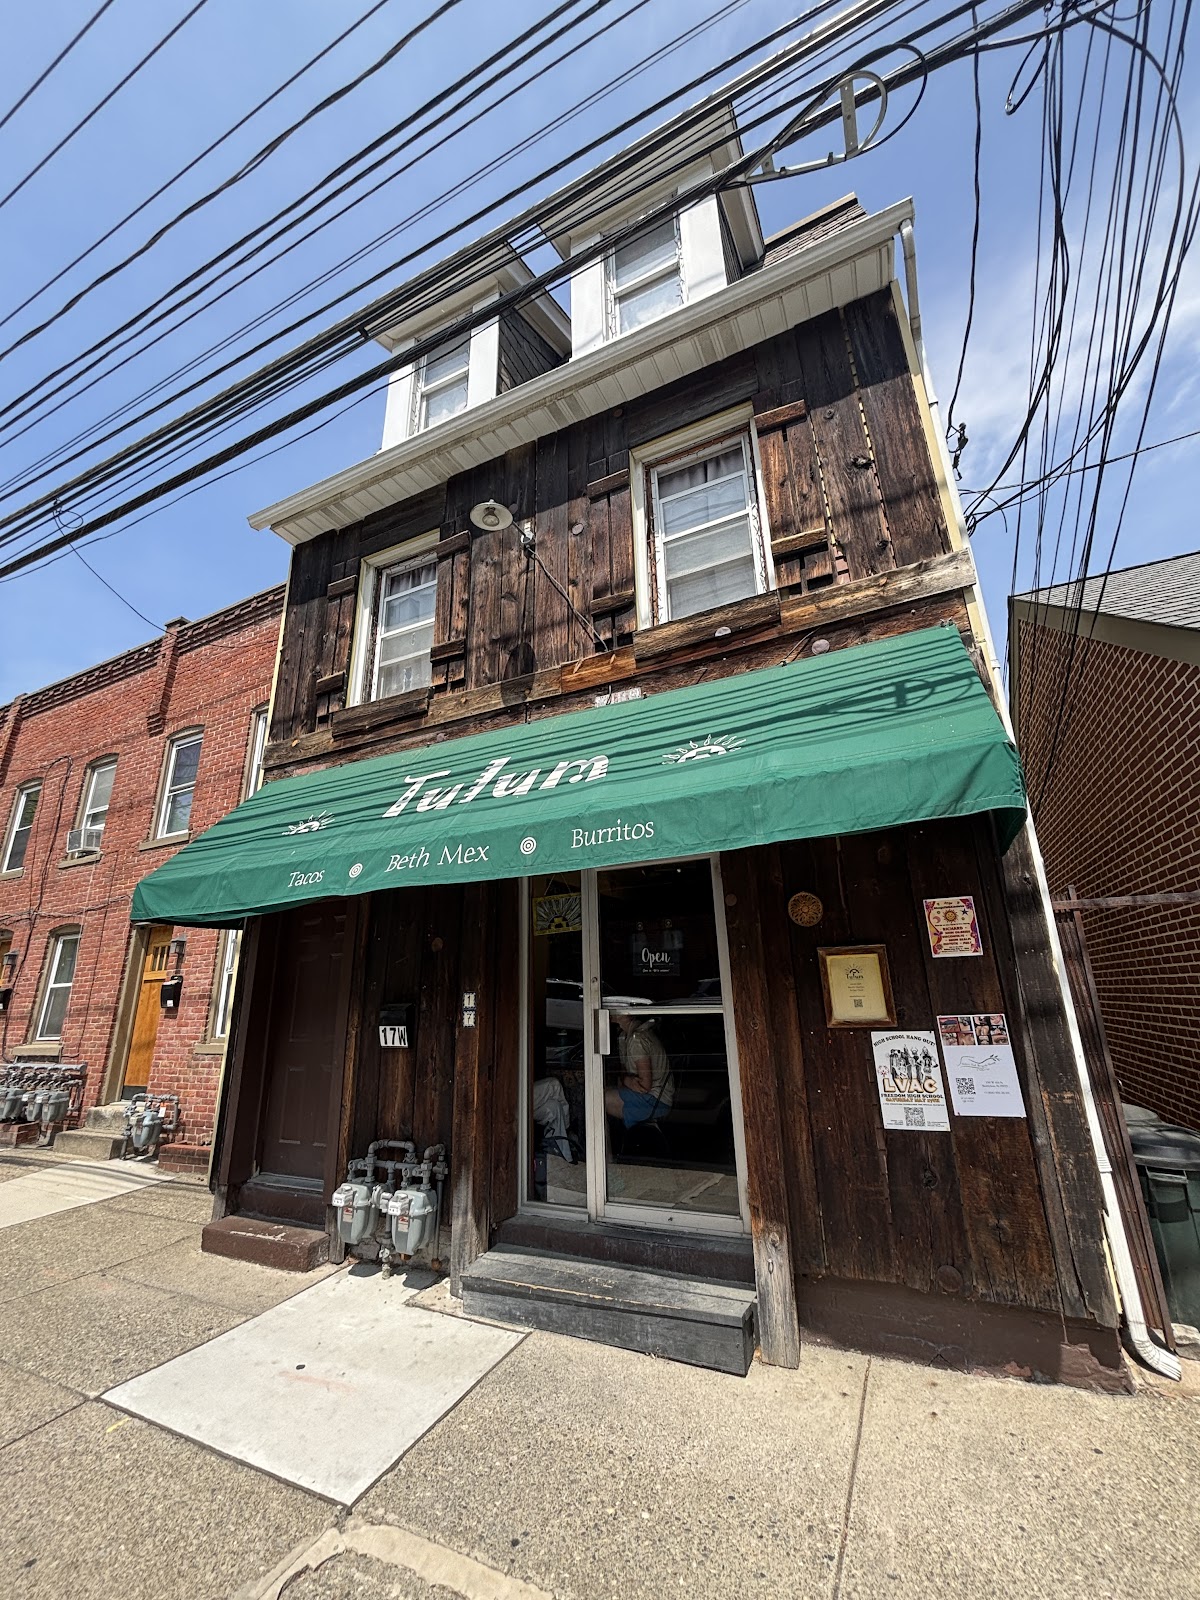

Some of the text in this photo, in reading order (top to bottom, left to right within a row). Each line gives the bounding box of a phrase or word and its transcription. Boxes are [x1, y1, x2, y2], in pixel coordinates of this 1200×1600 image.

[382, 755, 609, 818] Tulum
[571, 819, 654, 848] Burritos
[384, 844, 490, 872] Beth Mex
[288, 869, 325, 887] Tacos
[642, 948, 670, 968] Open
[382, 1027, 406, 1045] 17W
[873, 1038, 886, 1047] HIGH
[883, 1077, 938, 1093] LVAC
